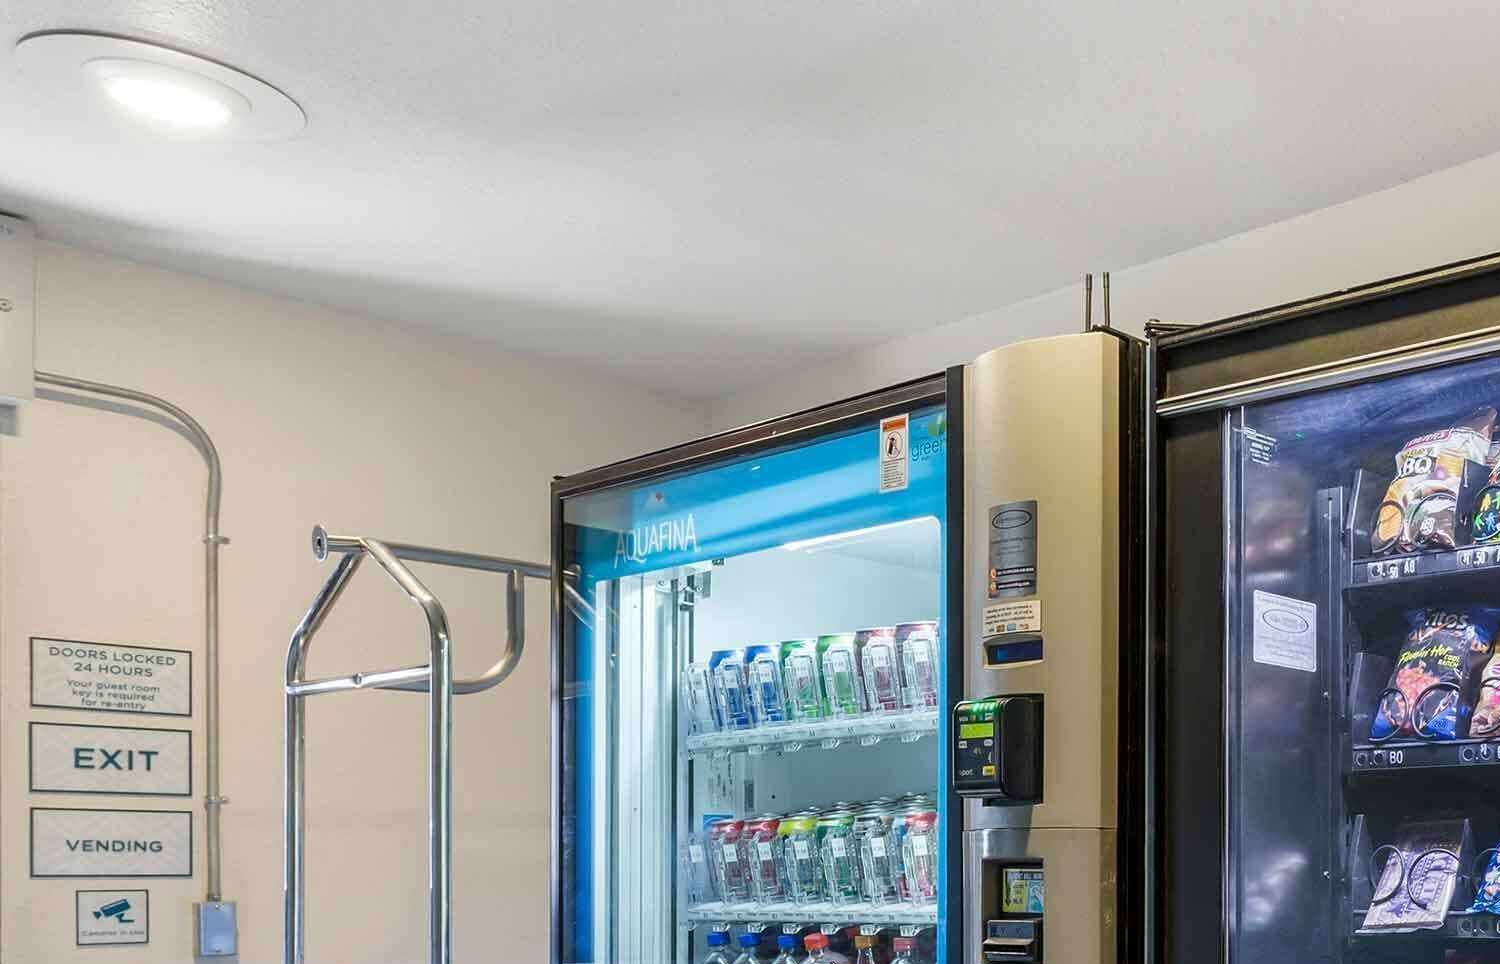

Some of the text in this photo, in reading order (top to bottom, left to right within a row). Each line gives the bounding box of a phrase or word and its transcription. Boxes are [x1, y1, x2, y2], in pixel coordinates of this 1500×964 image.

[614, 512, 699, 569] AQUAFINA
[49, 646, 176, 667] DOORS LOCKED
[73, 662, 153, 678] 24 HOURS
[66, 680, 161, 693] Your guest room
[72, 690, 92, 699] key
[108, 691, 155, 701] required
[81, 698, 146, 711] for re-entry
[74, 748, 159, 771] EXIT
[66, 840, 163, 853] VENDING
